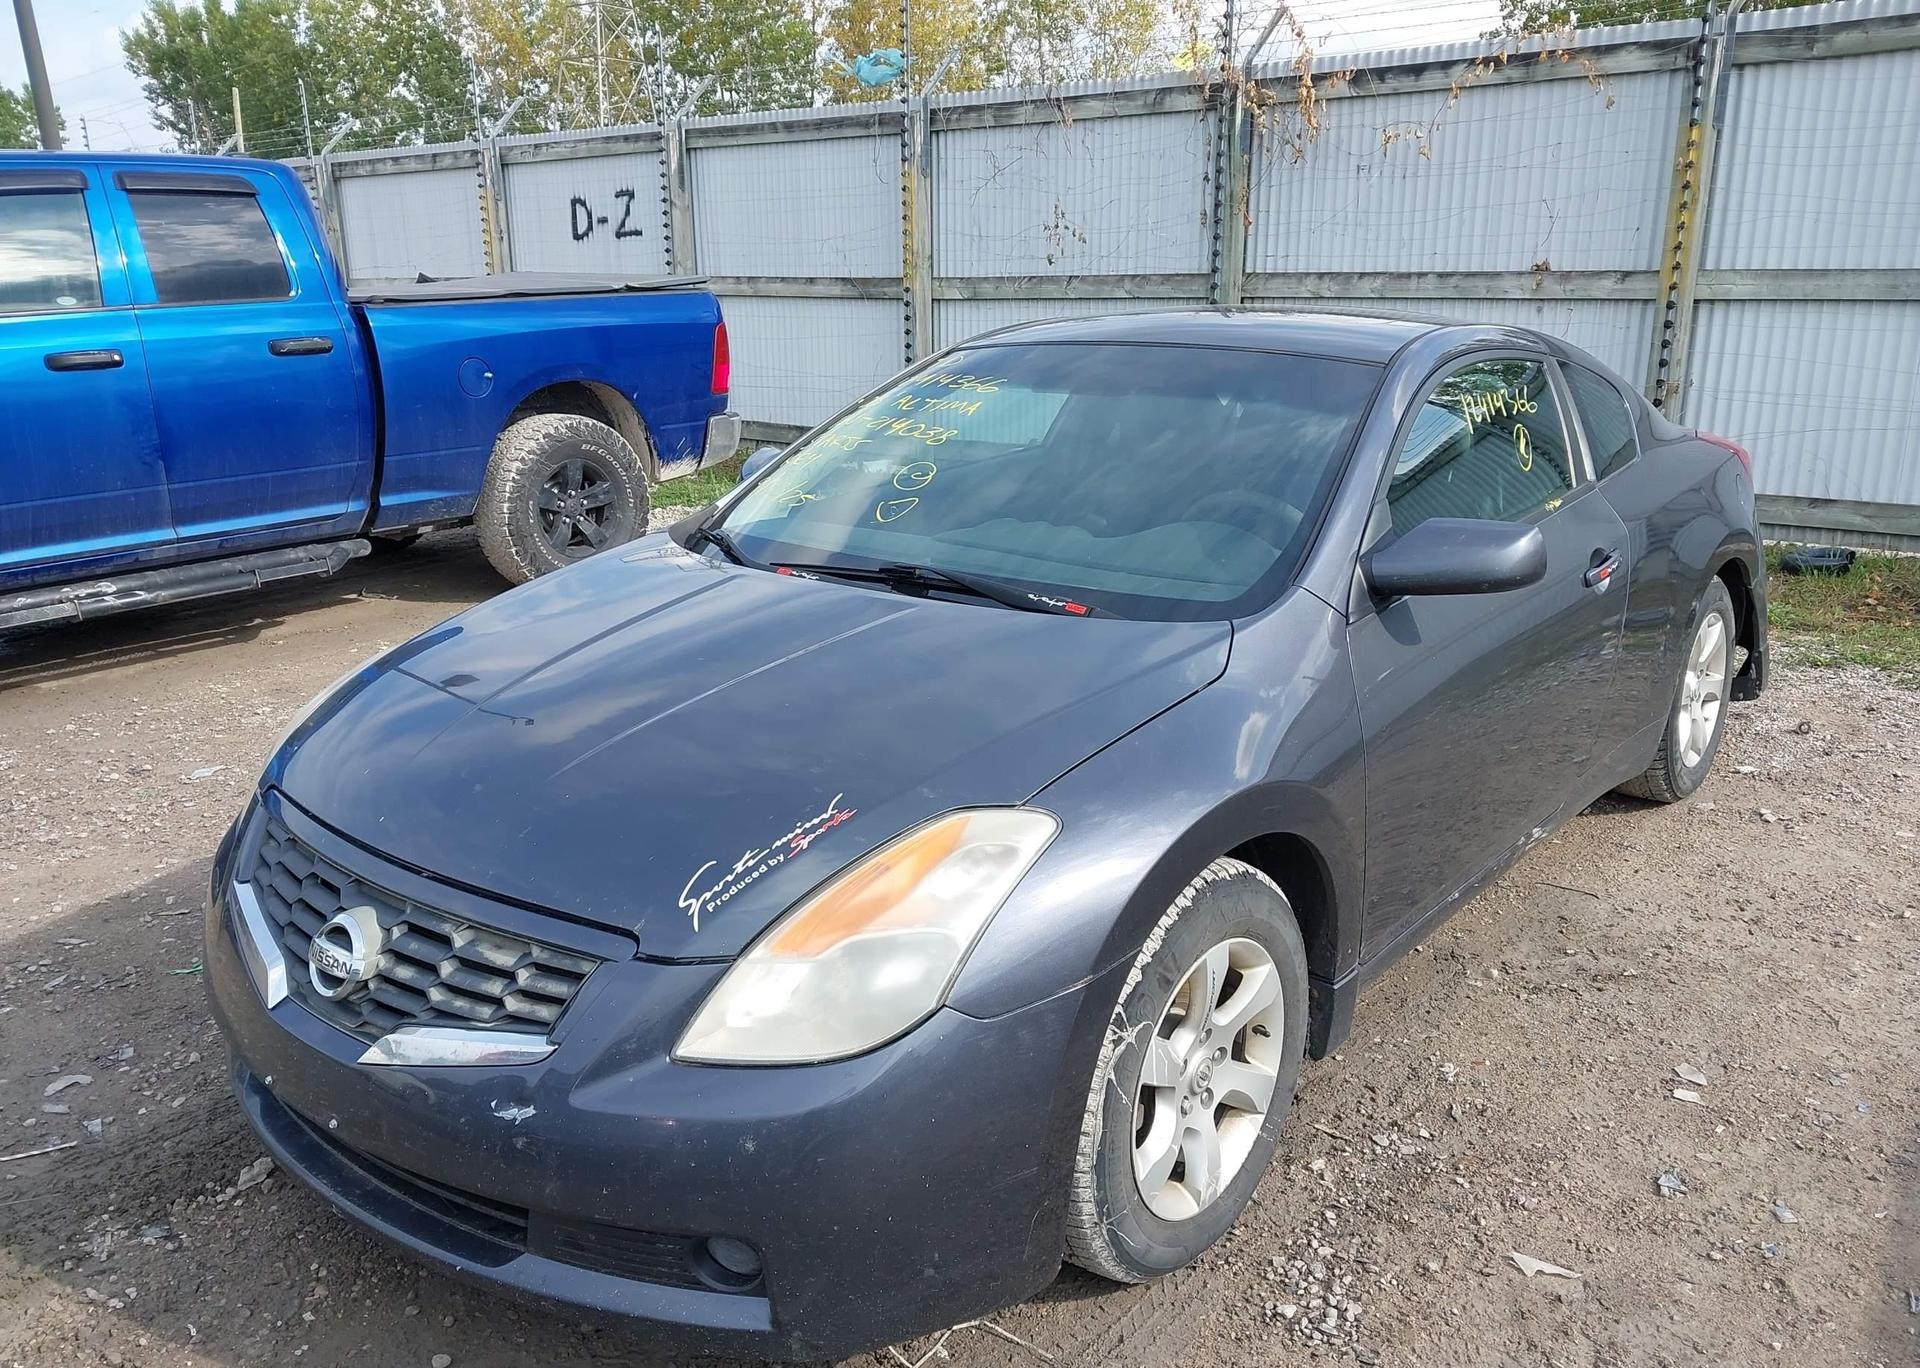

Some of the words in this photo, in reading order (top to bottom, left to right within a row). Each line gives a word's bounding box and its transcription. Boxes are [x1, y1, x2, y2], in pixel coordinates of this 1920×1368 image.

[570, 186, 642, 241] D-Z
[890, 392, 982, 416] ALTIMA
[581, 443, 635, 507] BFGoodrich
[678, 848, 769, 932] Sports
[706, 864, 768, 912] Produced
[770, 853, 785, 867] by
[310, 943, 353, 976] NISSAN
